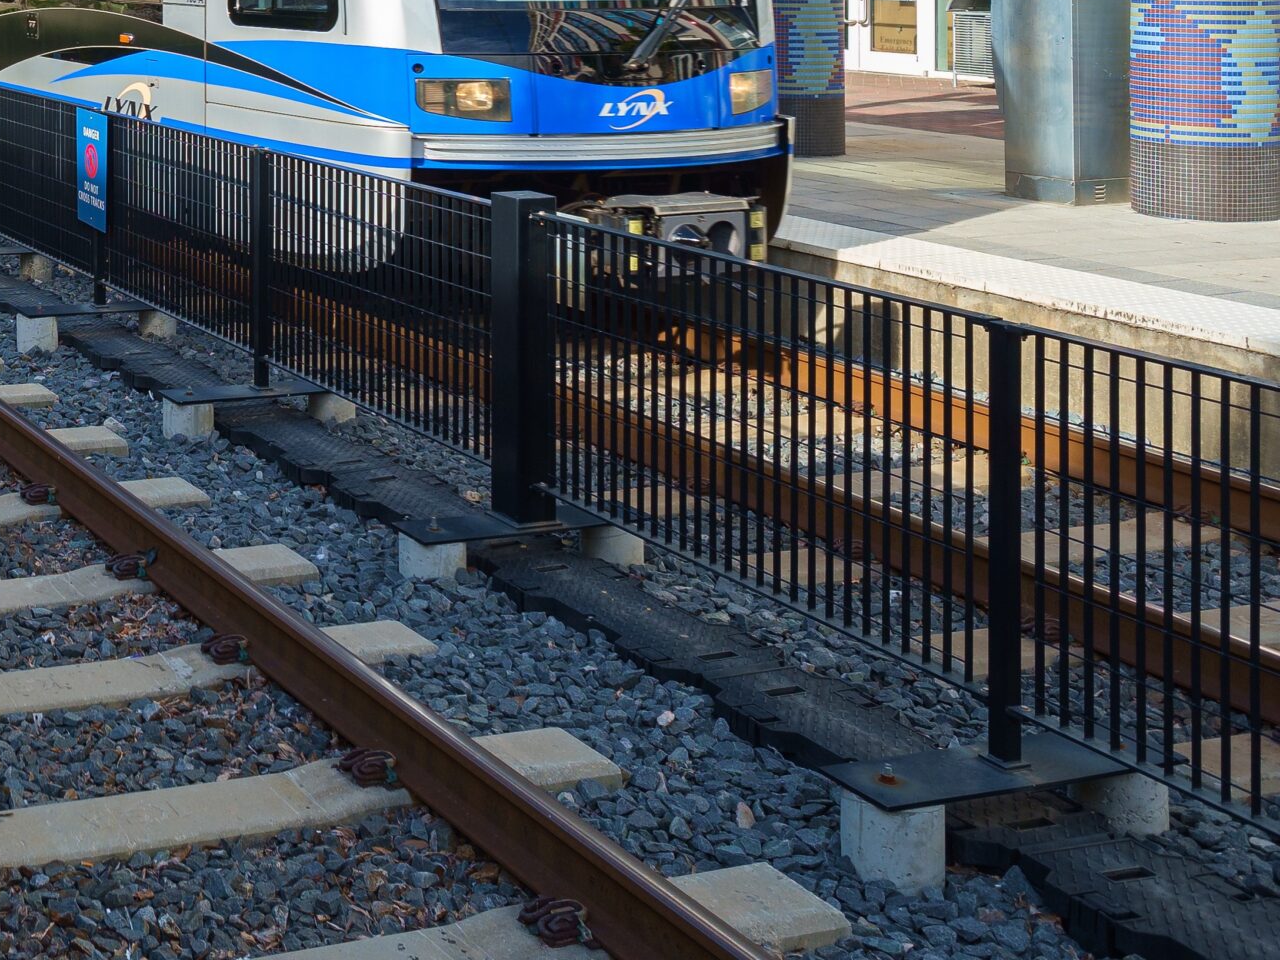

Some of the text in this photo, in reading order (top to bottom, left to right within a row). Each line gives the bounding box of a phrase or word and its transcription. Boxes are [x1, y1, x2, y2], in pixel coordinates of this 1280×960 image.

[598, 100, 674, 117] LYNX
[83, 126, 100, 141] DANGER
[84, 181, 99, 196] DO NOT
[78, 190, 105, 211] CROSS TRACKS
